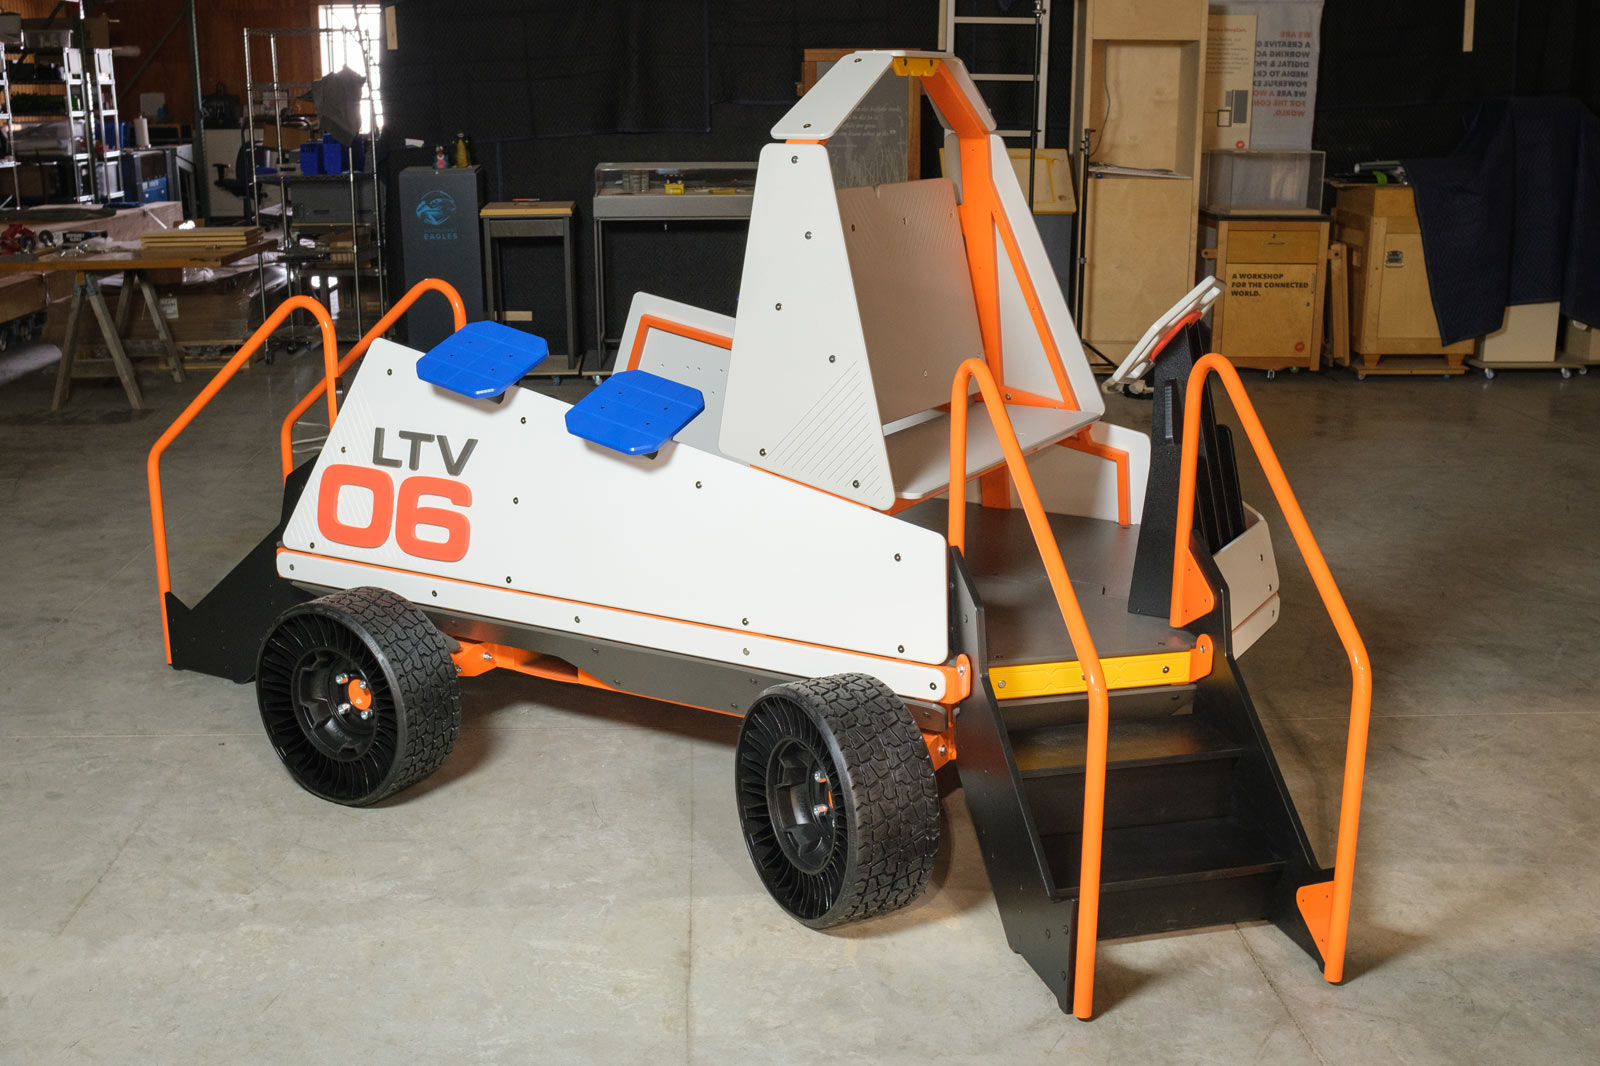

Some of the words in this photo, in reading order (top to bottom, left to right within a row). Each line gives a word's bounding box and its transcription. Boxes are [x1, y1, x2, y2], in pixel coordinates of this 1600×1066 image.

[423, 232, 458, 240] EAGLES
[372, 427, 478, 476] LTV
[317, 463, 472, 562] 06
